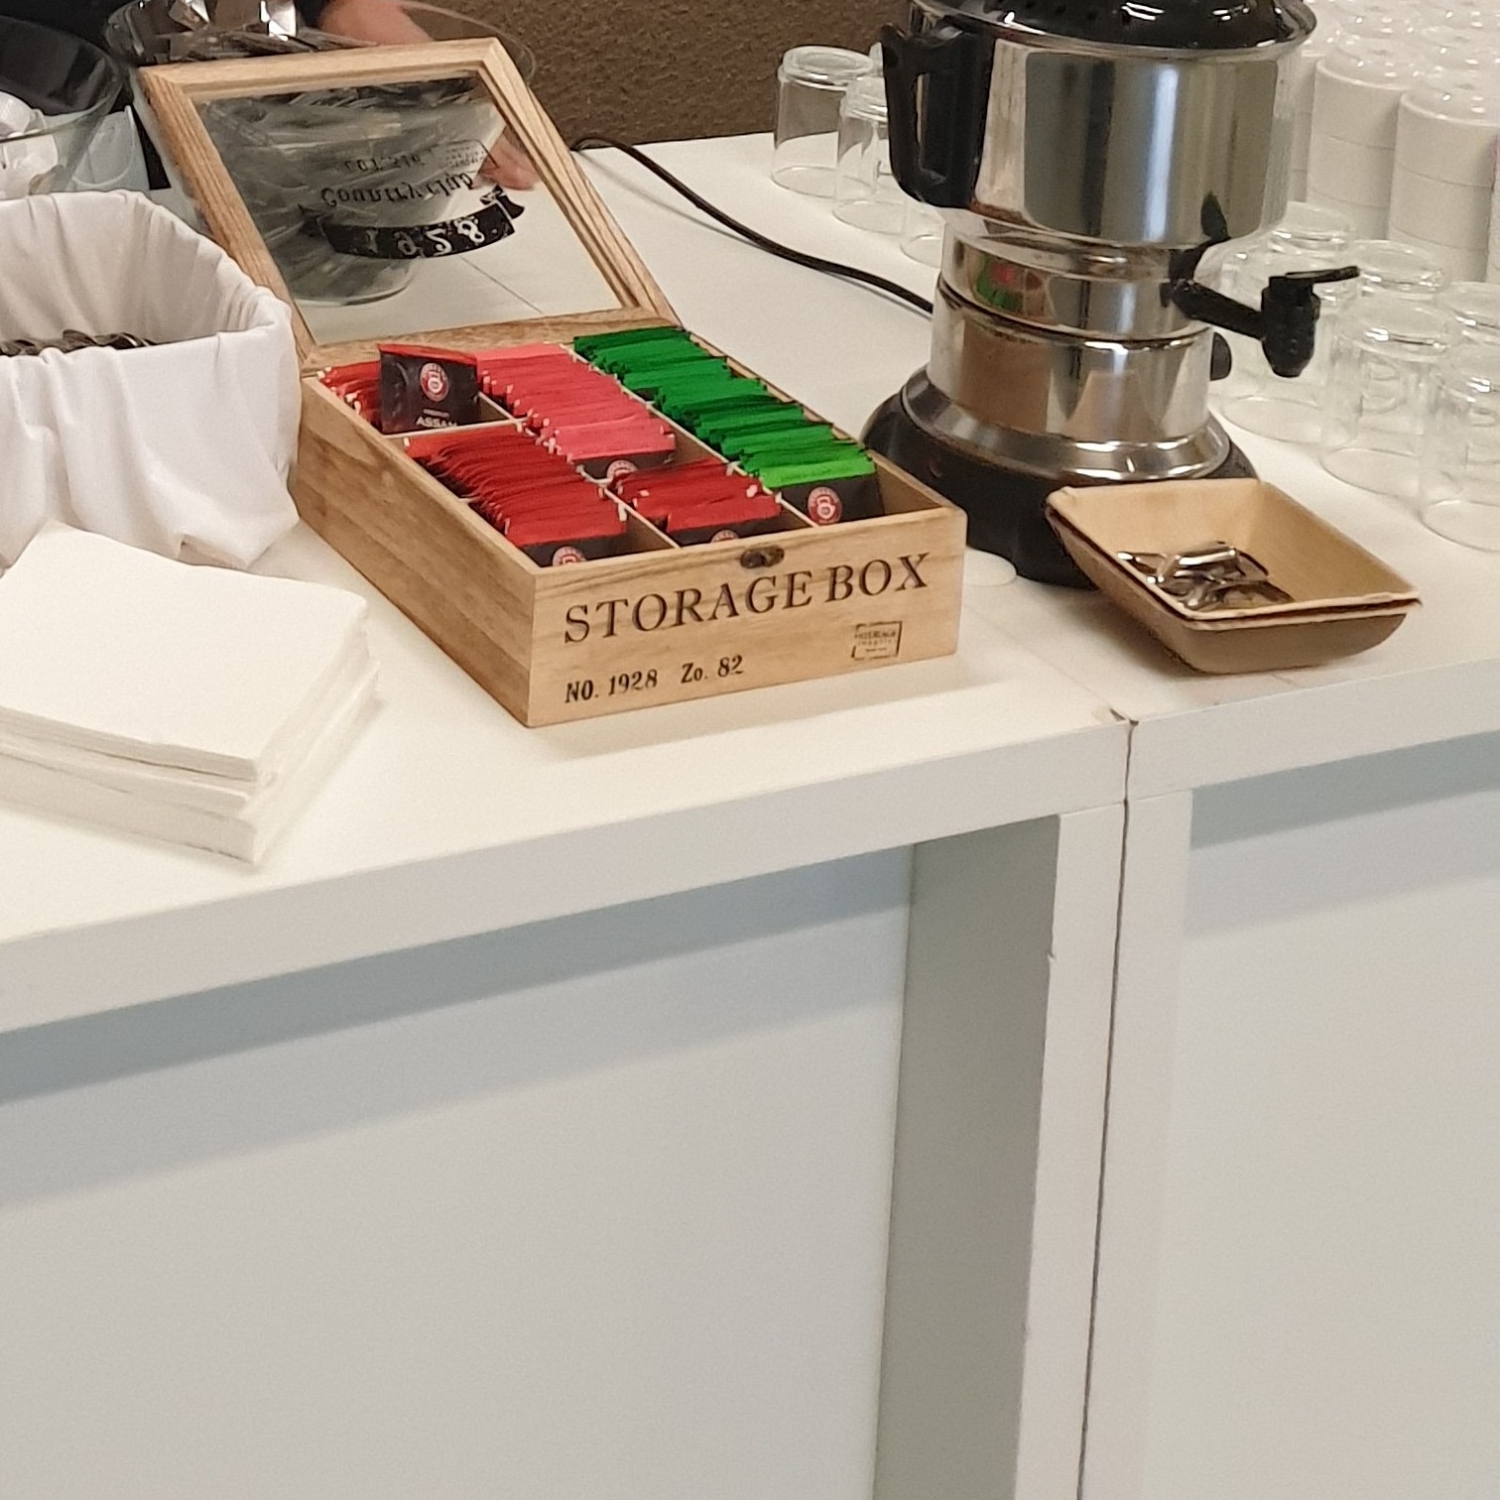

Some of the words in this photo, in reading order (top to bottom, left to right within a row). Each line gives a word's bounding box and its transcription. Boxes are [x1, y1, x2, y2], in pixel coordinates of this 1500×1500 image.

[564, 571, 813, 644] STORAGE
[825, 552, 931, 602] BOX
[565, 679, 599, 704] NO.
[608, 669, 658, 696] 1928
[717, 654, 744, 678] 82
